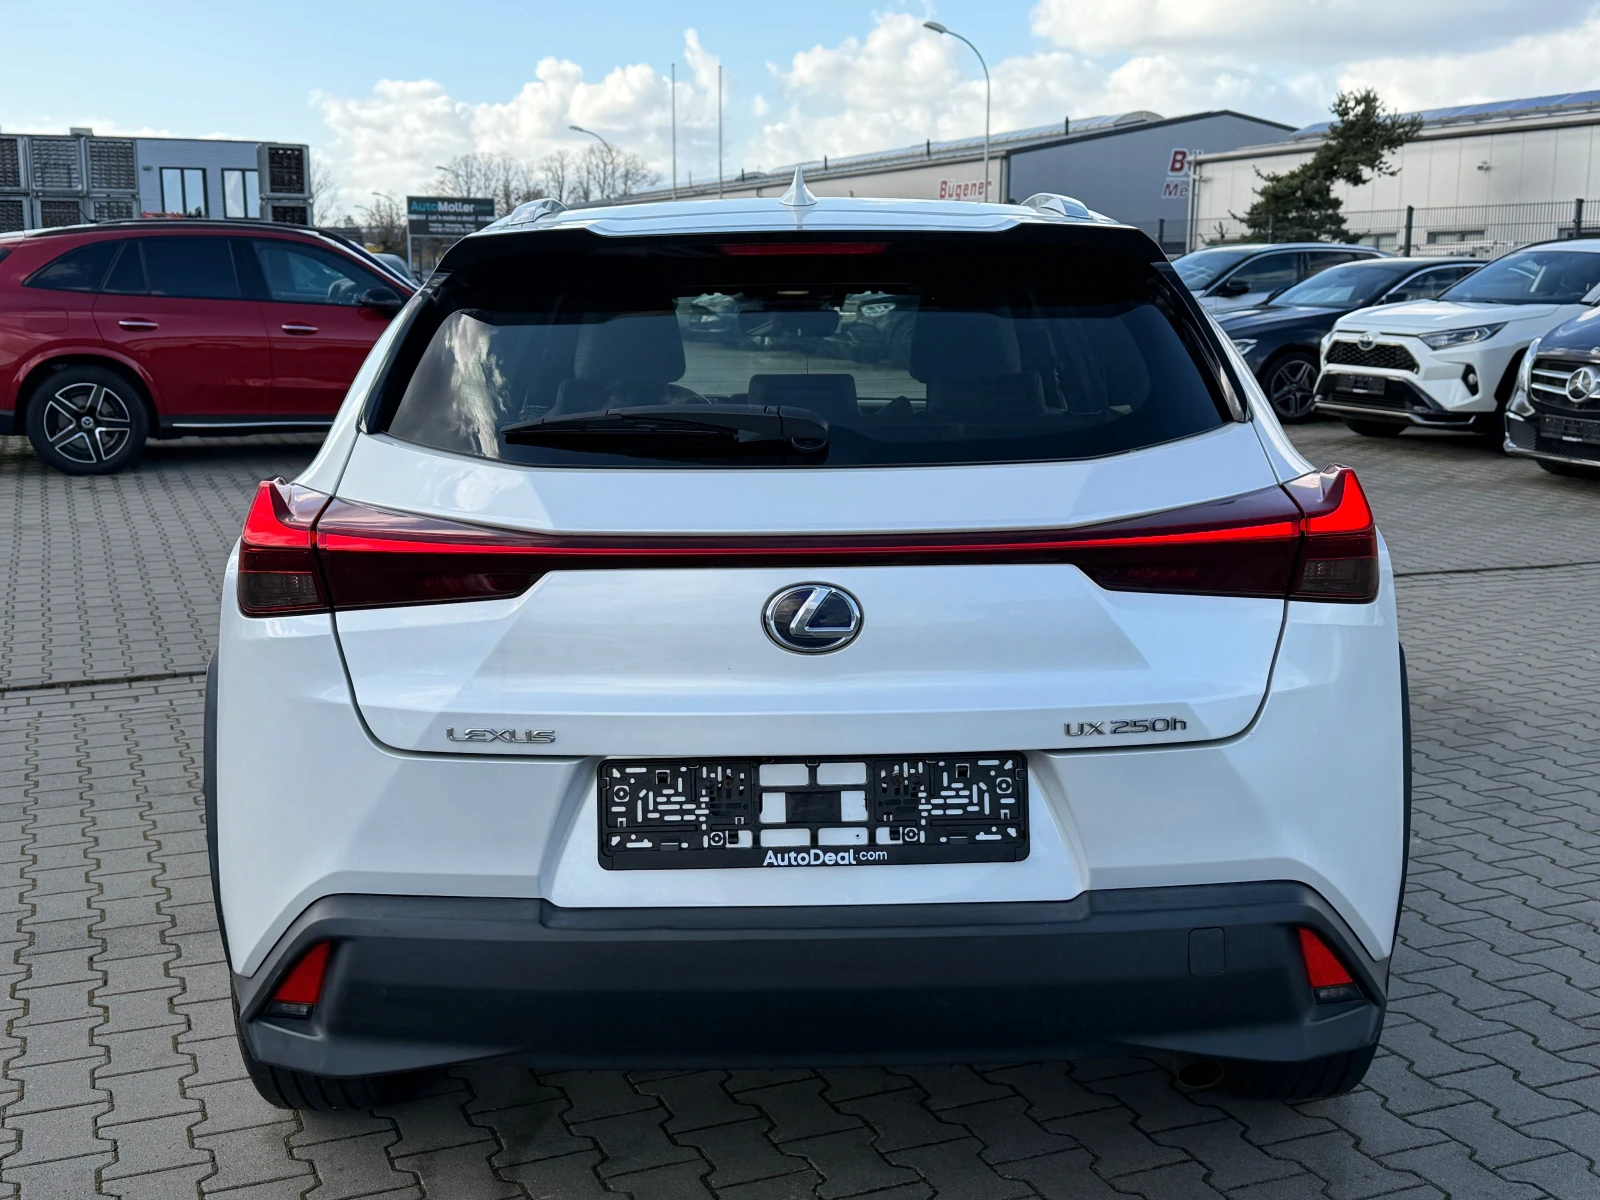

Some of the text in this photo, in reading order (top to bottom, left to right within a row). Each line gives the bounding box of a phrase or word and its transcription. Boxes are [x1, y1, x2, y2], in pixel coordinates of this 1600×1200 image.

[446, 727, 556, 743] LEXUS
[1064, 716, 1187, 736] UX 250h
